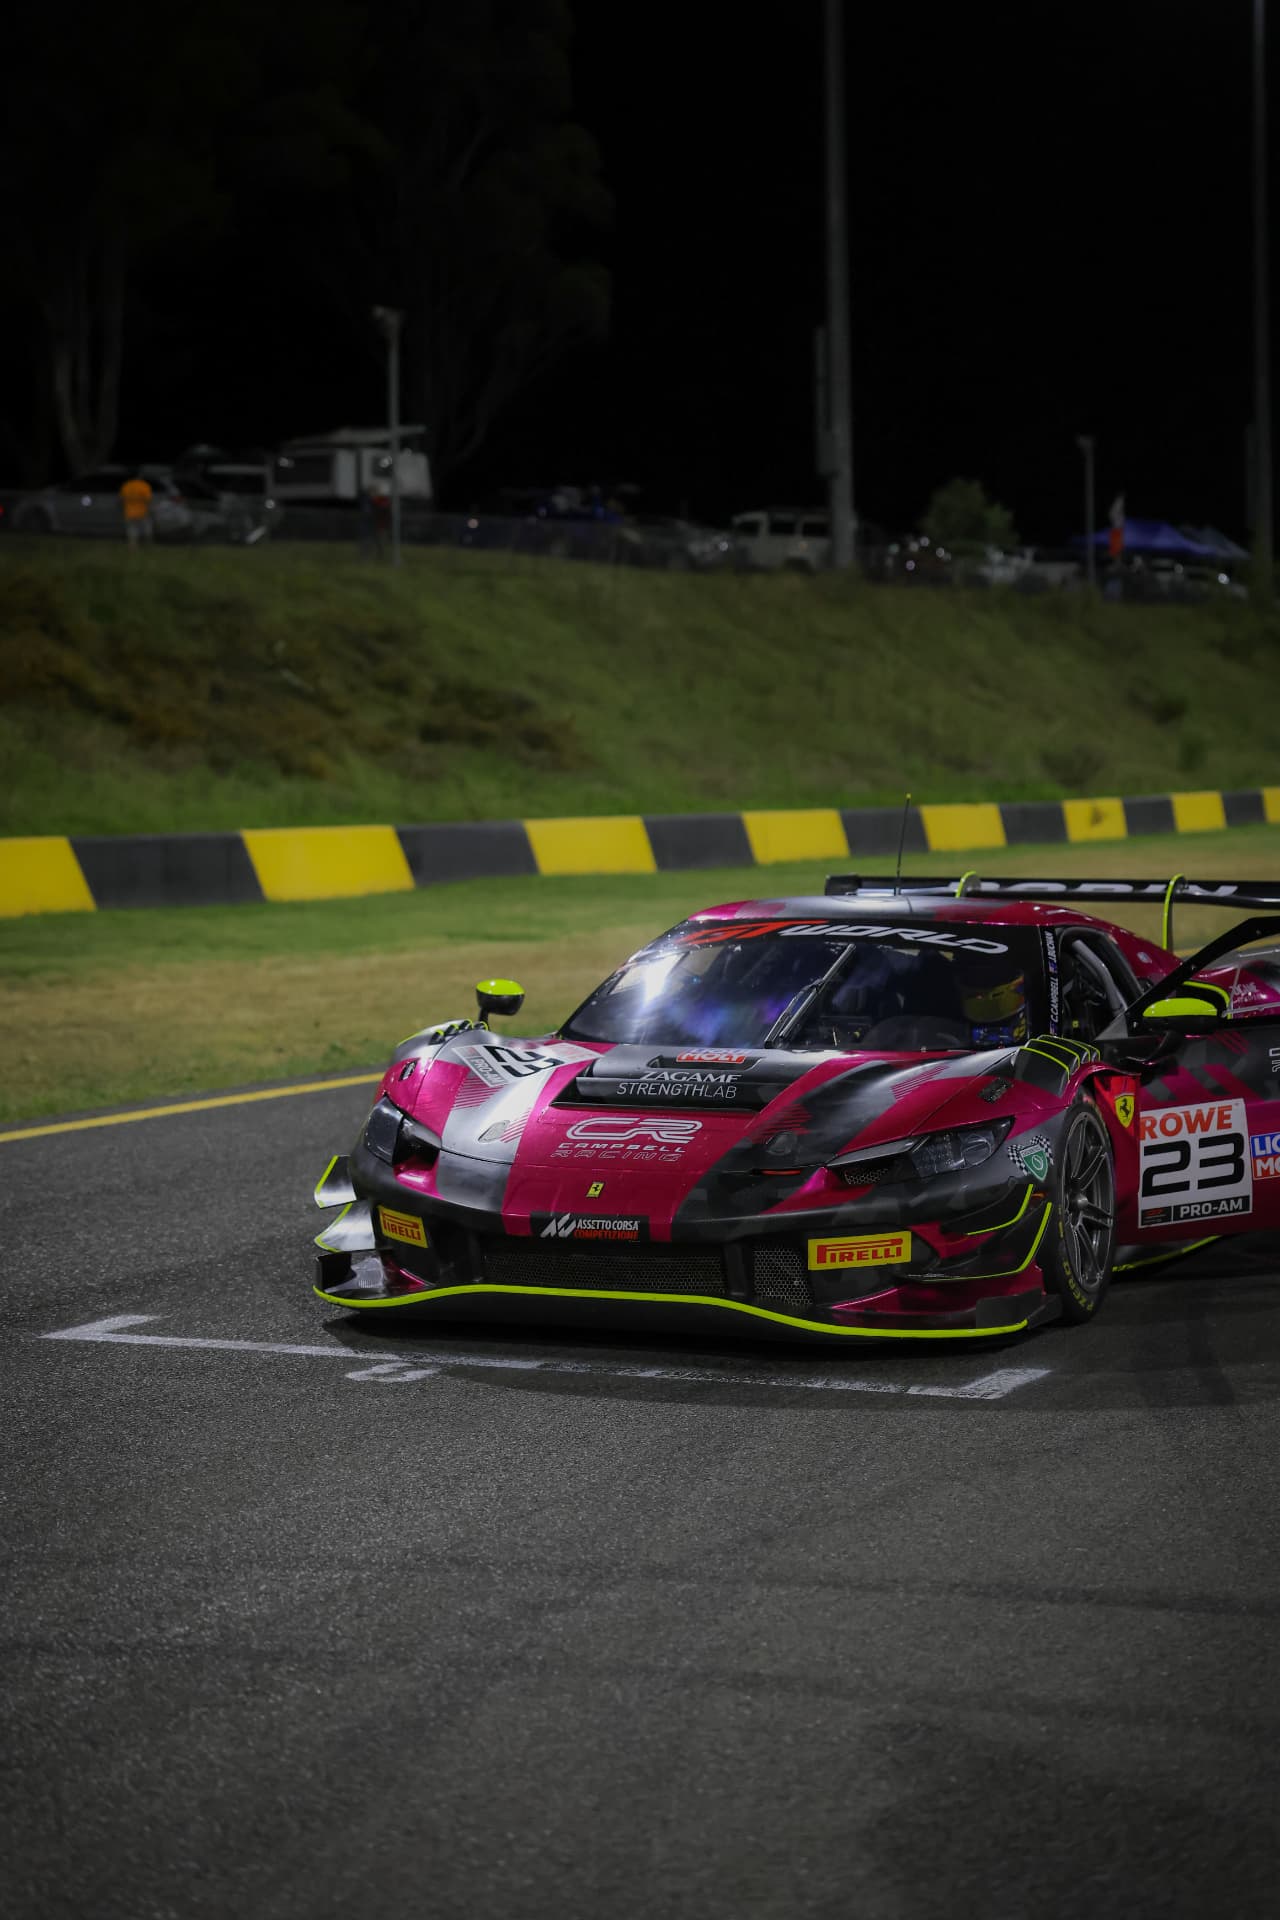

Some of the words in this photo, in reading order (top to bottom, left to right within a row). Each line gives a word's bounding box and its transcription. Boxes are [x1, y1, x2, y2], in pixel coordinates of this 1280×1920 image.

[778, 924, 1008, 954] WORLD
[680, 1052, 747, 1063] MOLY
[616, 1082, 737, 1099] STRENGTHLAB
[566, 1117, 703, 1144] CR
[1140, 1105, 1233, 1141] ROWE
[551, 1150, 682, 1162] RACING
[558, 1143, 686, 1153] CAMPBELL
[1142, 1132, 1244, 1197] 23
[1179, 1198, 1243, 1218] PRO-AM
[382, 1213, 421, 1241] PIRELLI
[574, 1229, 639, 1240] COMPETIZIONE
[577, 1220, 611, 1230] ASSETTO
[612, 1220, 639, 1231] CORSA
[816, 1238, 903, 1264] PIRELLI
